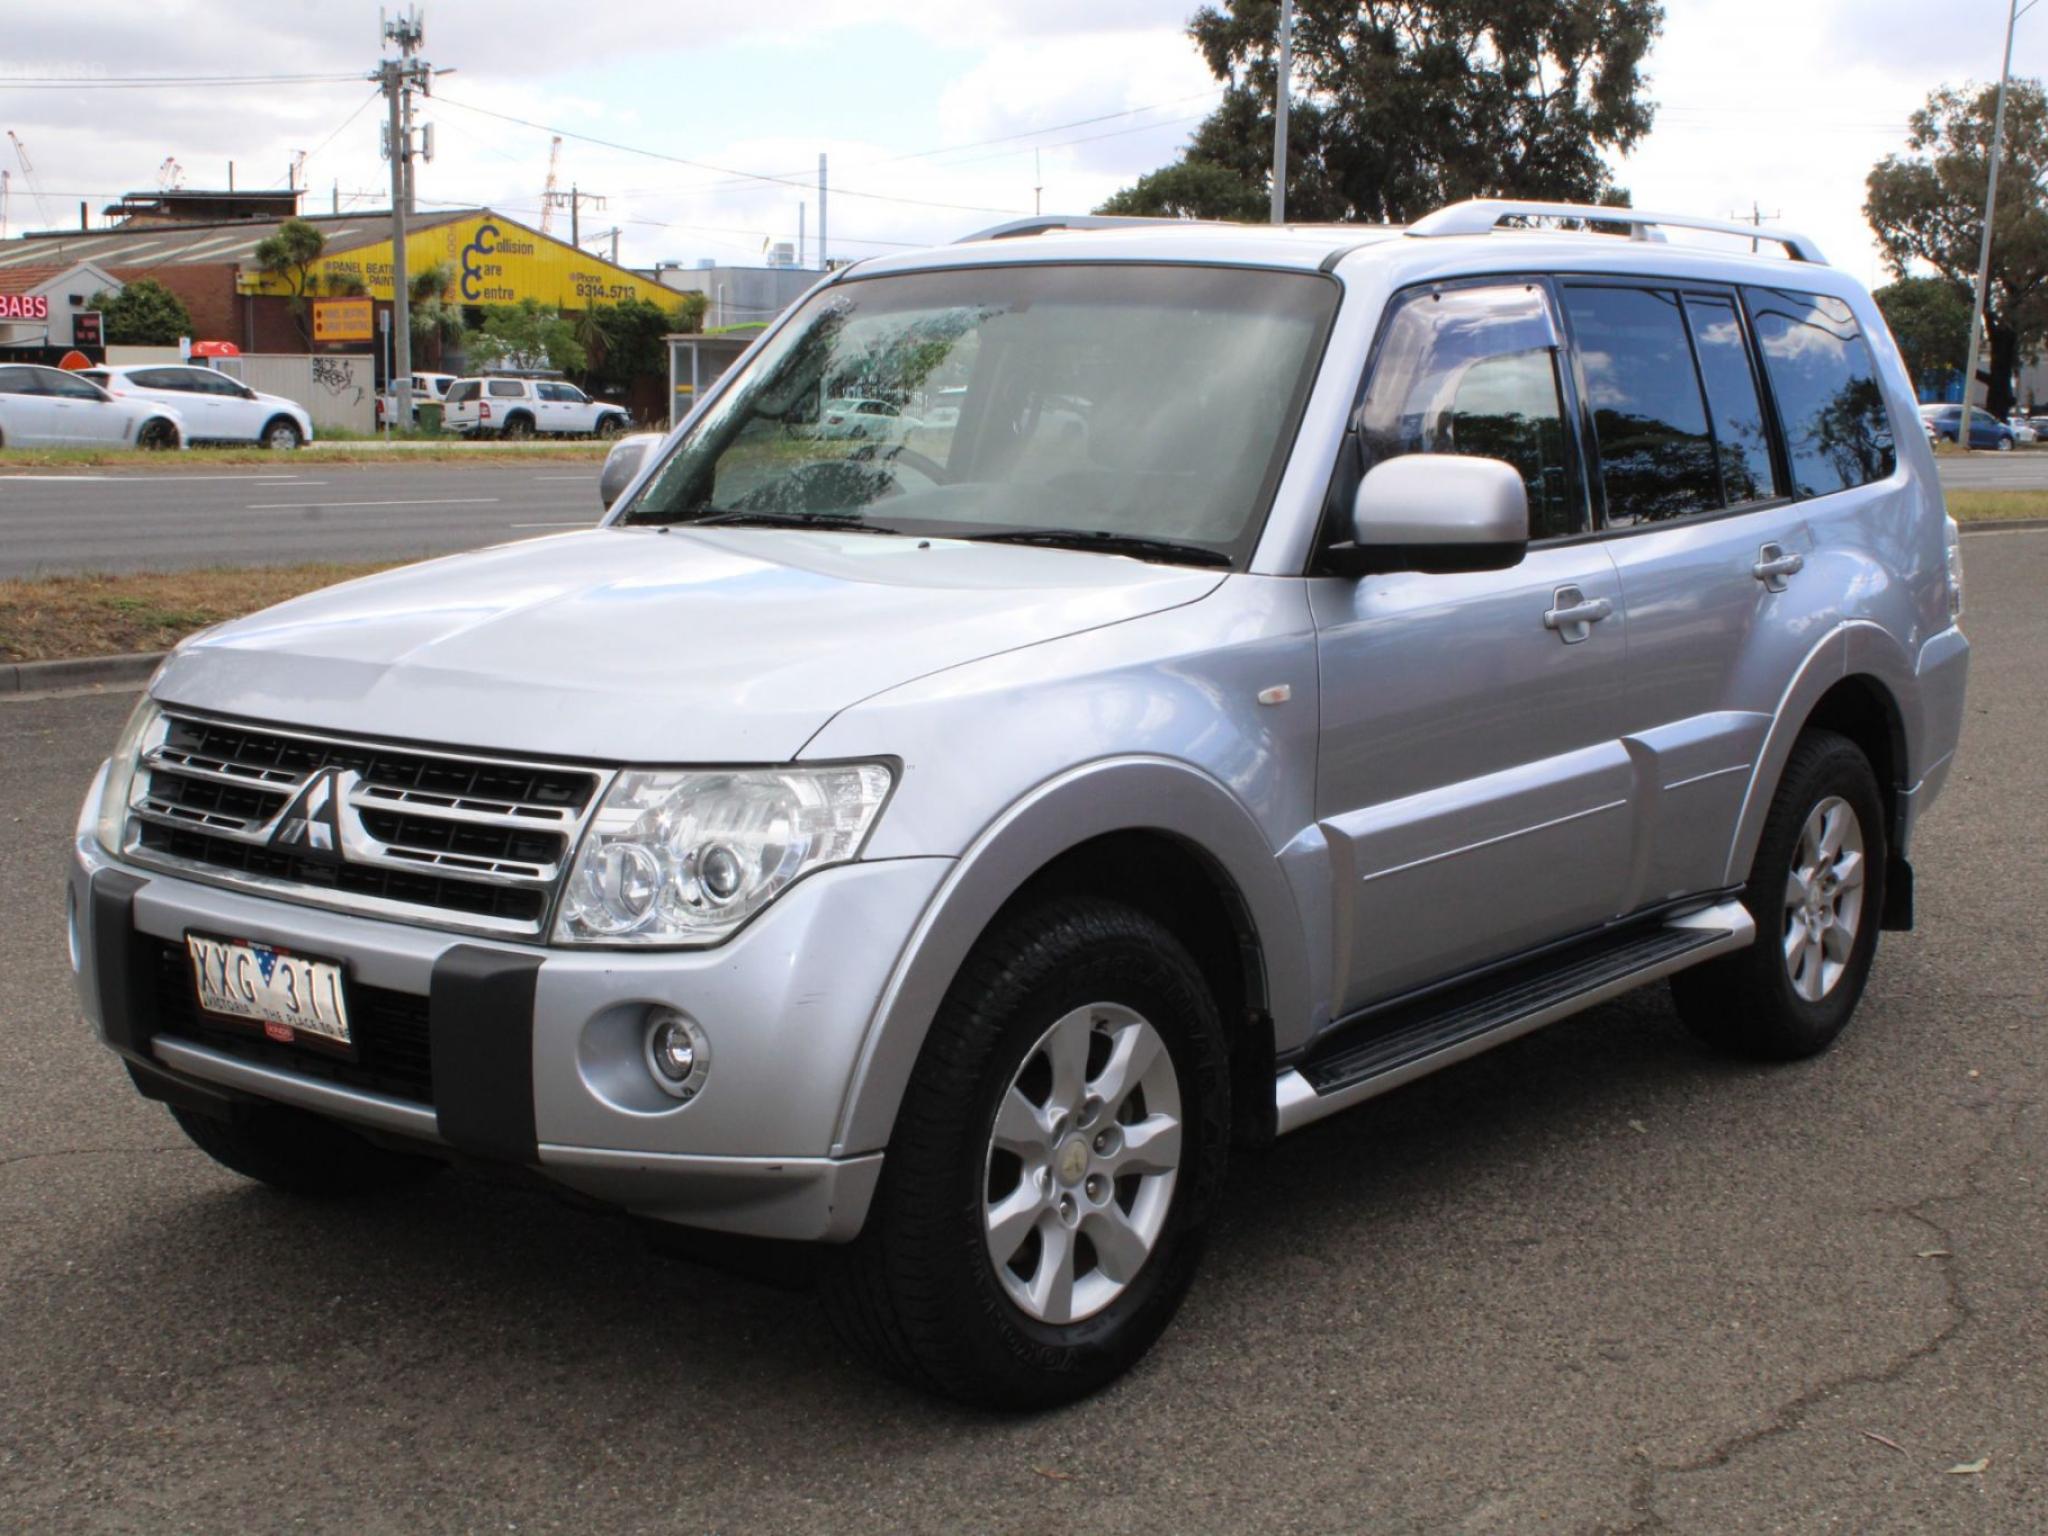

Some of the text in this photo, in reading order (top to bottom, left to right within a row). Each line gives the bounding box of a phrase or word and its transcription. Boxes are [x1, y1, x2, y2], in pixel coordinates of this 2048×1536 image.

[476, 225, 535, 256] Collision
[333, 261, 361, 273] PANEL
[462, 244, 502, 276] Care
[461, 269, 514, 300] Centre
[576, 272, 602, 283] Phone
[0, 296, 47, 318] BABS
[193, 942, 345, 1027] XXG 311
